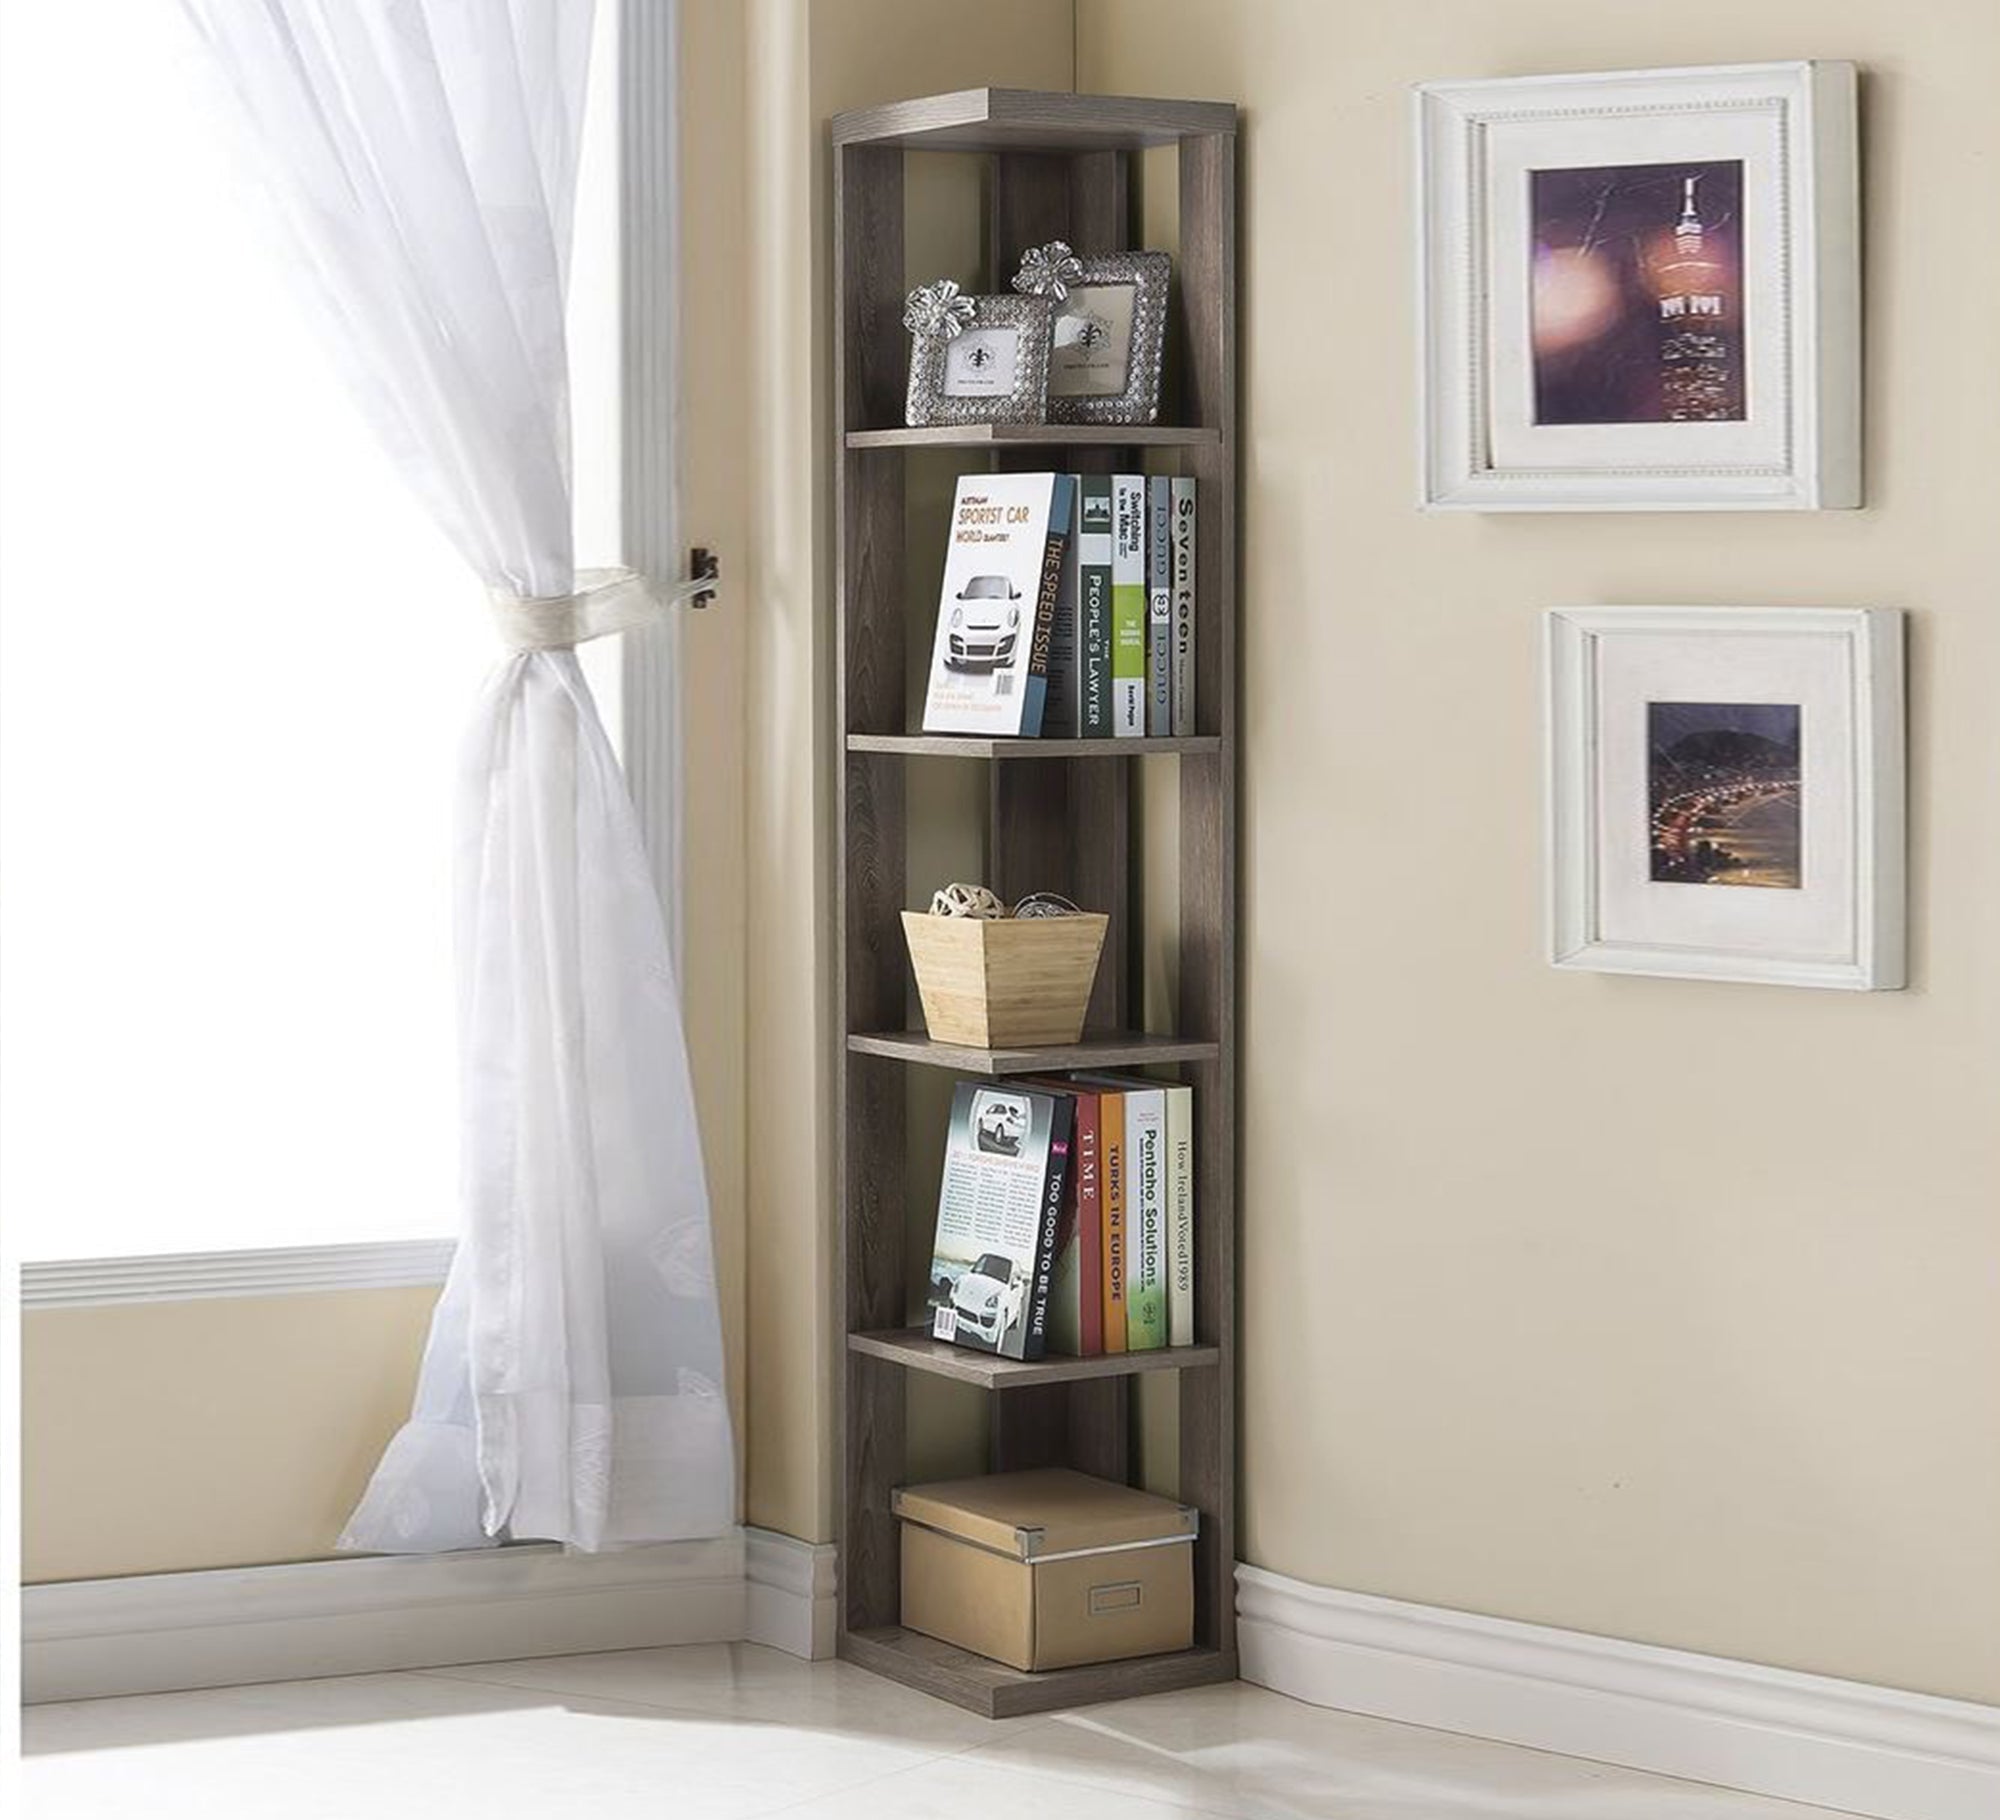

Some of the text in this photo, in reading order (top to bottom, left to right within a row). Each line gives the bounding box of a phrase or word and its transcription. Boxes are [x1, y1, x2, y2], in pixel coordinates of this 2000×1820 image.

[1006, 506, 1030, 524] CAR
[1119, 513, 1130, 540] Mac
[1128, 491, 1142, 553] Switching
[1031, 538, 1063, 673] THE SPEED ISSUE
[1089, 574, 1102, 725] PEOPLE'S LAWYER
[1082, 1130, 1095, 1200] TIME
[1145, 1129, 1157, 1201] Pentaho
[1177, 1141, 1188, 1170] How
[1033, 1172, 1062, 1336] TOO GOOD TO BE TRUE
[1110, 1144, 1121, 1301] TURKS IN EUROPE
[1145, 1208, 1158, 1287] Solutions
